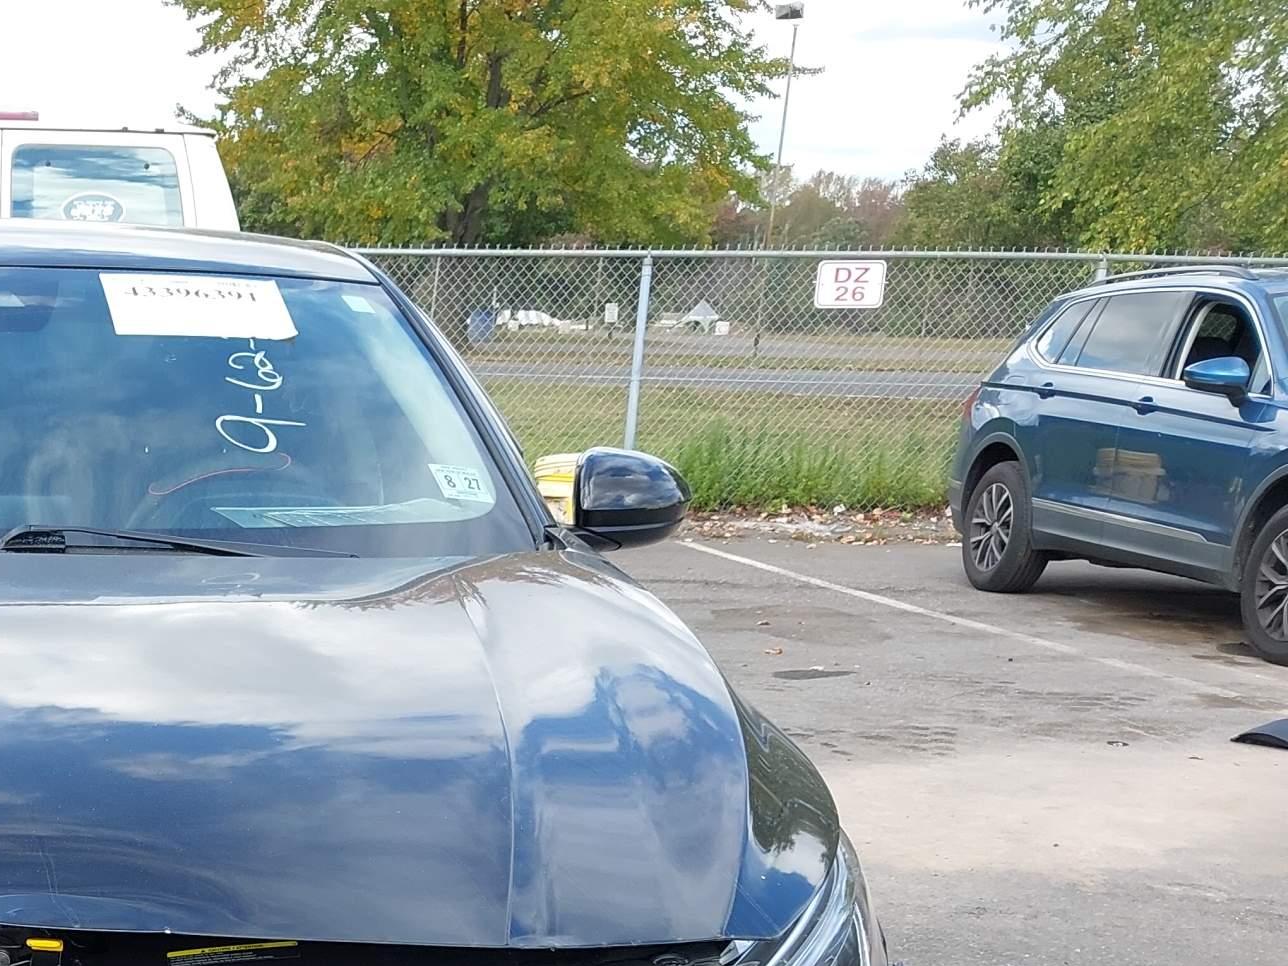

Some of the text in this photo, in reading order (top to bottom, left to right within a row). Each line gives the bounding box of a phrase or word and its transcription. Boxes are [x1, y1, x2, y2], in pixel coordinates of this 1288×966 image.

[834, 267, 870, 283] DZ
[834, 286, 865, 302] 26
[444, 474, 481, 490] 8 27
